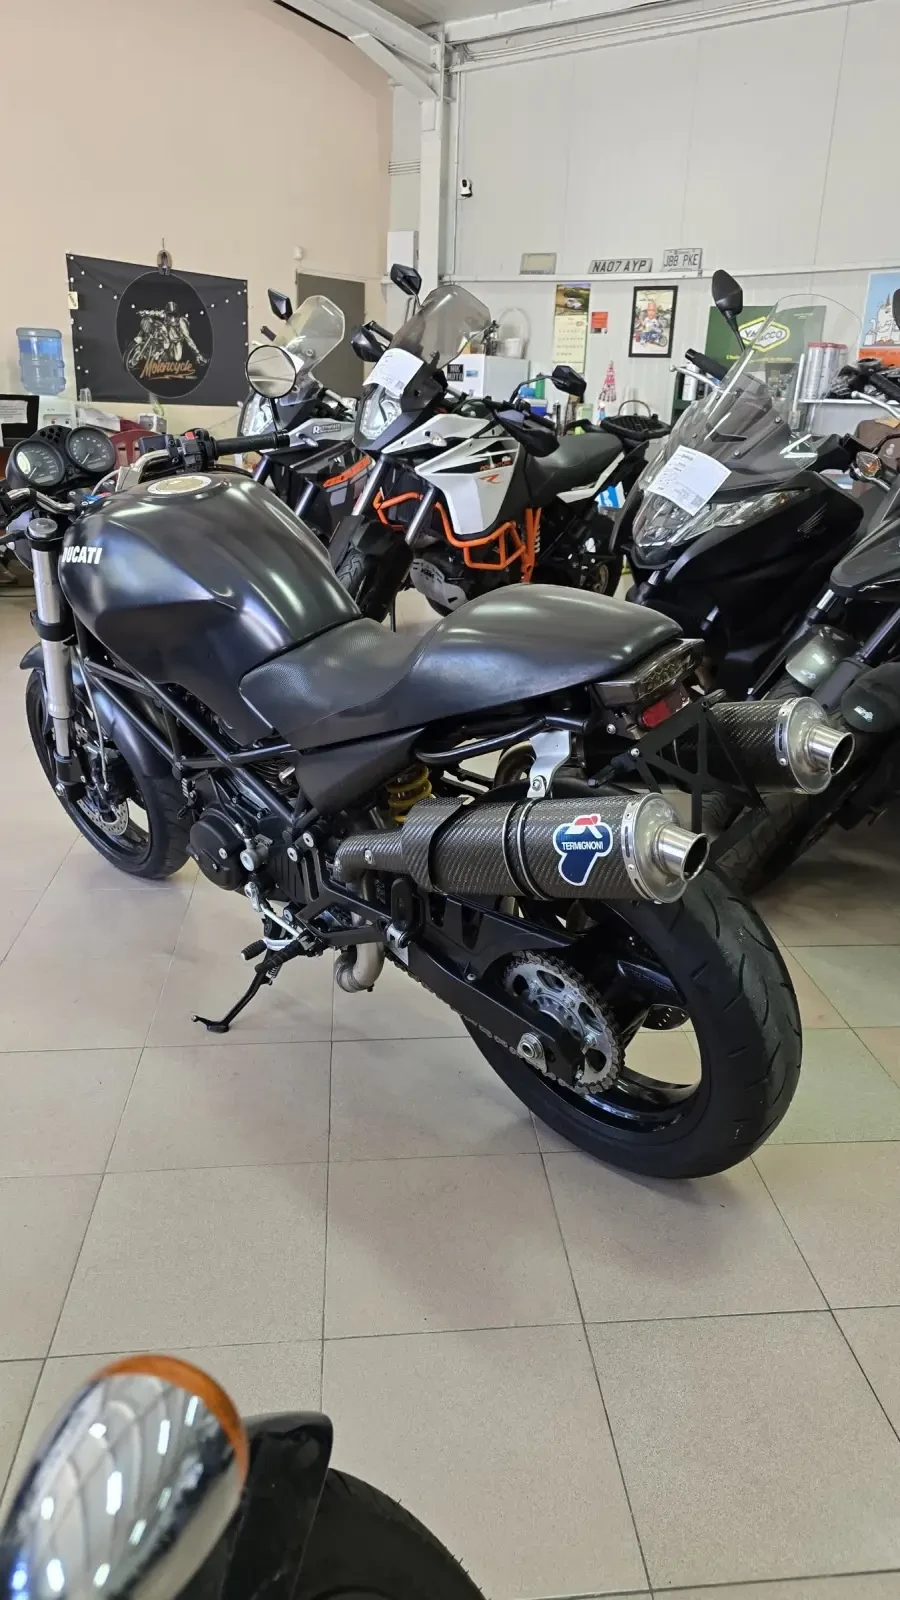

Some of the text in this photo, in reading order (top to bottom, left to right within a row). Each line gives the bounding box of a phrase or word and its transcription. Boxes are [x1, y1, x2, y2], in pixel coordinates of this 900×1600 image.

[624, 260, 647, 272] AYP
[683, 254, 699, 266] PKE
[140, 359, 196, 378] Motorcycle
[61, 545, 103, 565] DUCATI
[561, 840, 604, 851] TERMIGNONI
